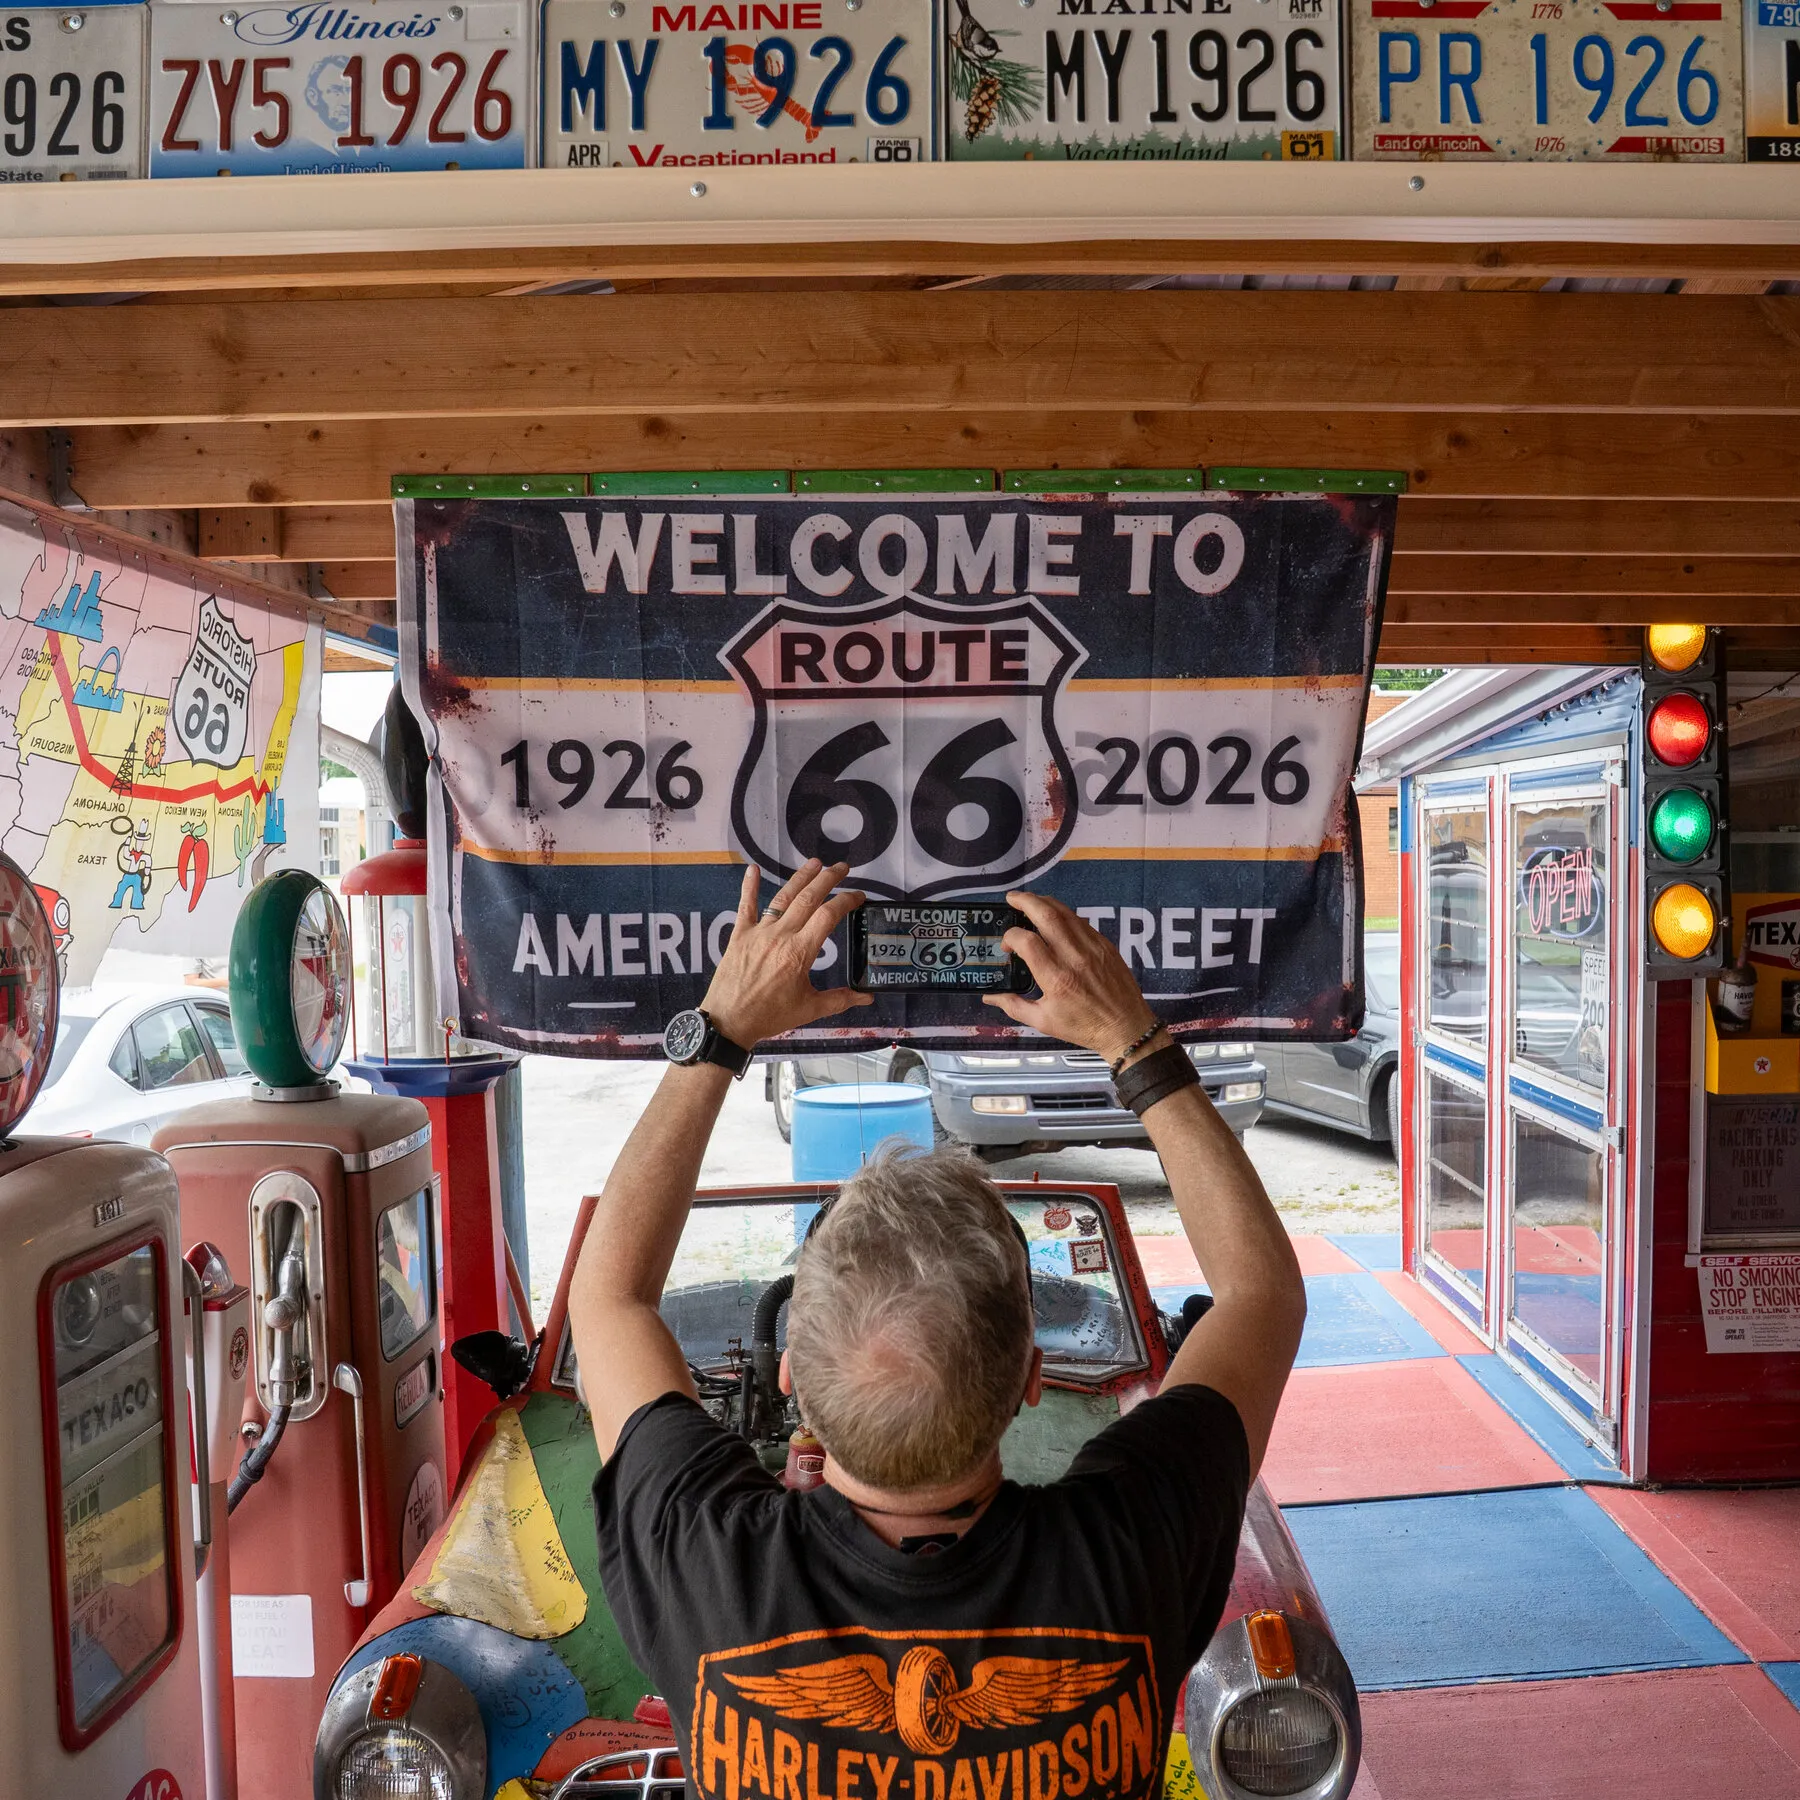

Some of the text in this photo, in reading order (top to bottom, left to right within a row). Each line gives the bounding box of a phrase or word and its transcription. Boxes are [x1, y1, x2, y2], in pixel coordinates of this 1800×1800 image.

[652, 2, 823, 32] MAINE
[1531, 3, 1563, 20] 1776
[234, 1, 441, 45] Illinois
[560, 36, 910, 132] MY 1926
[1378, 31, 1719, 127] PR 1926
[161, 49, 512, 152] ZY5 1926
[876, 139, 911, 147] MAINE
[1063, 141, 1230, 161] Vacationland
[1289, 140, 1324, 156] 01
[1375, 136, 1481, 151] Land of Lincoln
[1534, 136, 1566, 152] 1976
[567, 143, 602, 167] APR
[627, 144, 837, 168] Vacationland
[873, 146, 912, 162] 00
[559, 511, 1246, 598] WELCOME TO
[780, 629, 1030, 684] ROUTE
[500, 739, 704, 811] 1926
[1093, 735, 1311, 806] 2026
[785, 718, 1024, 868] 66
[1528, 847, 1593, 935] OPEN
[883, 908, 994, 924] WELCOME TO
[918, 928, 960, 937] ROUTE
[870, 944, 906, 957] 1926
[919, 942, 958, 966] 66
[870, 971, 928, 985] AMERICA'S
[931, 971, 957, 983] MAIN
[1719, 1126, 1798, 1147] RACING FANS
[1732, 1148, 1784, 1168] PARKING
[1743, 1169, 1773, 1188] ONLY
[1705, 1256, 1744, 1266] SELF
[1713, 1268, 1734, 1288] NO
[1709, 1288, 1746, 1308] STOP
[63, 1377, 150, 1450] TEXACO
[407, 1479, 438, 1526] TEXACO
